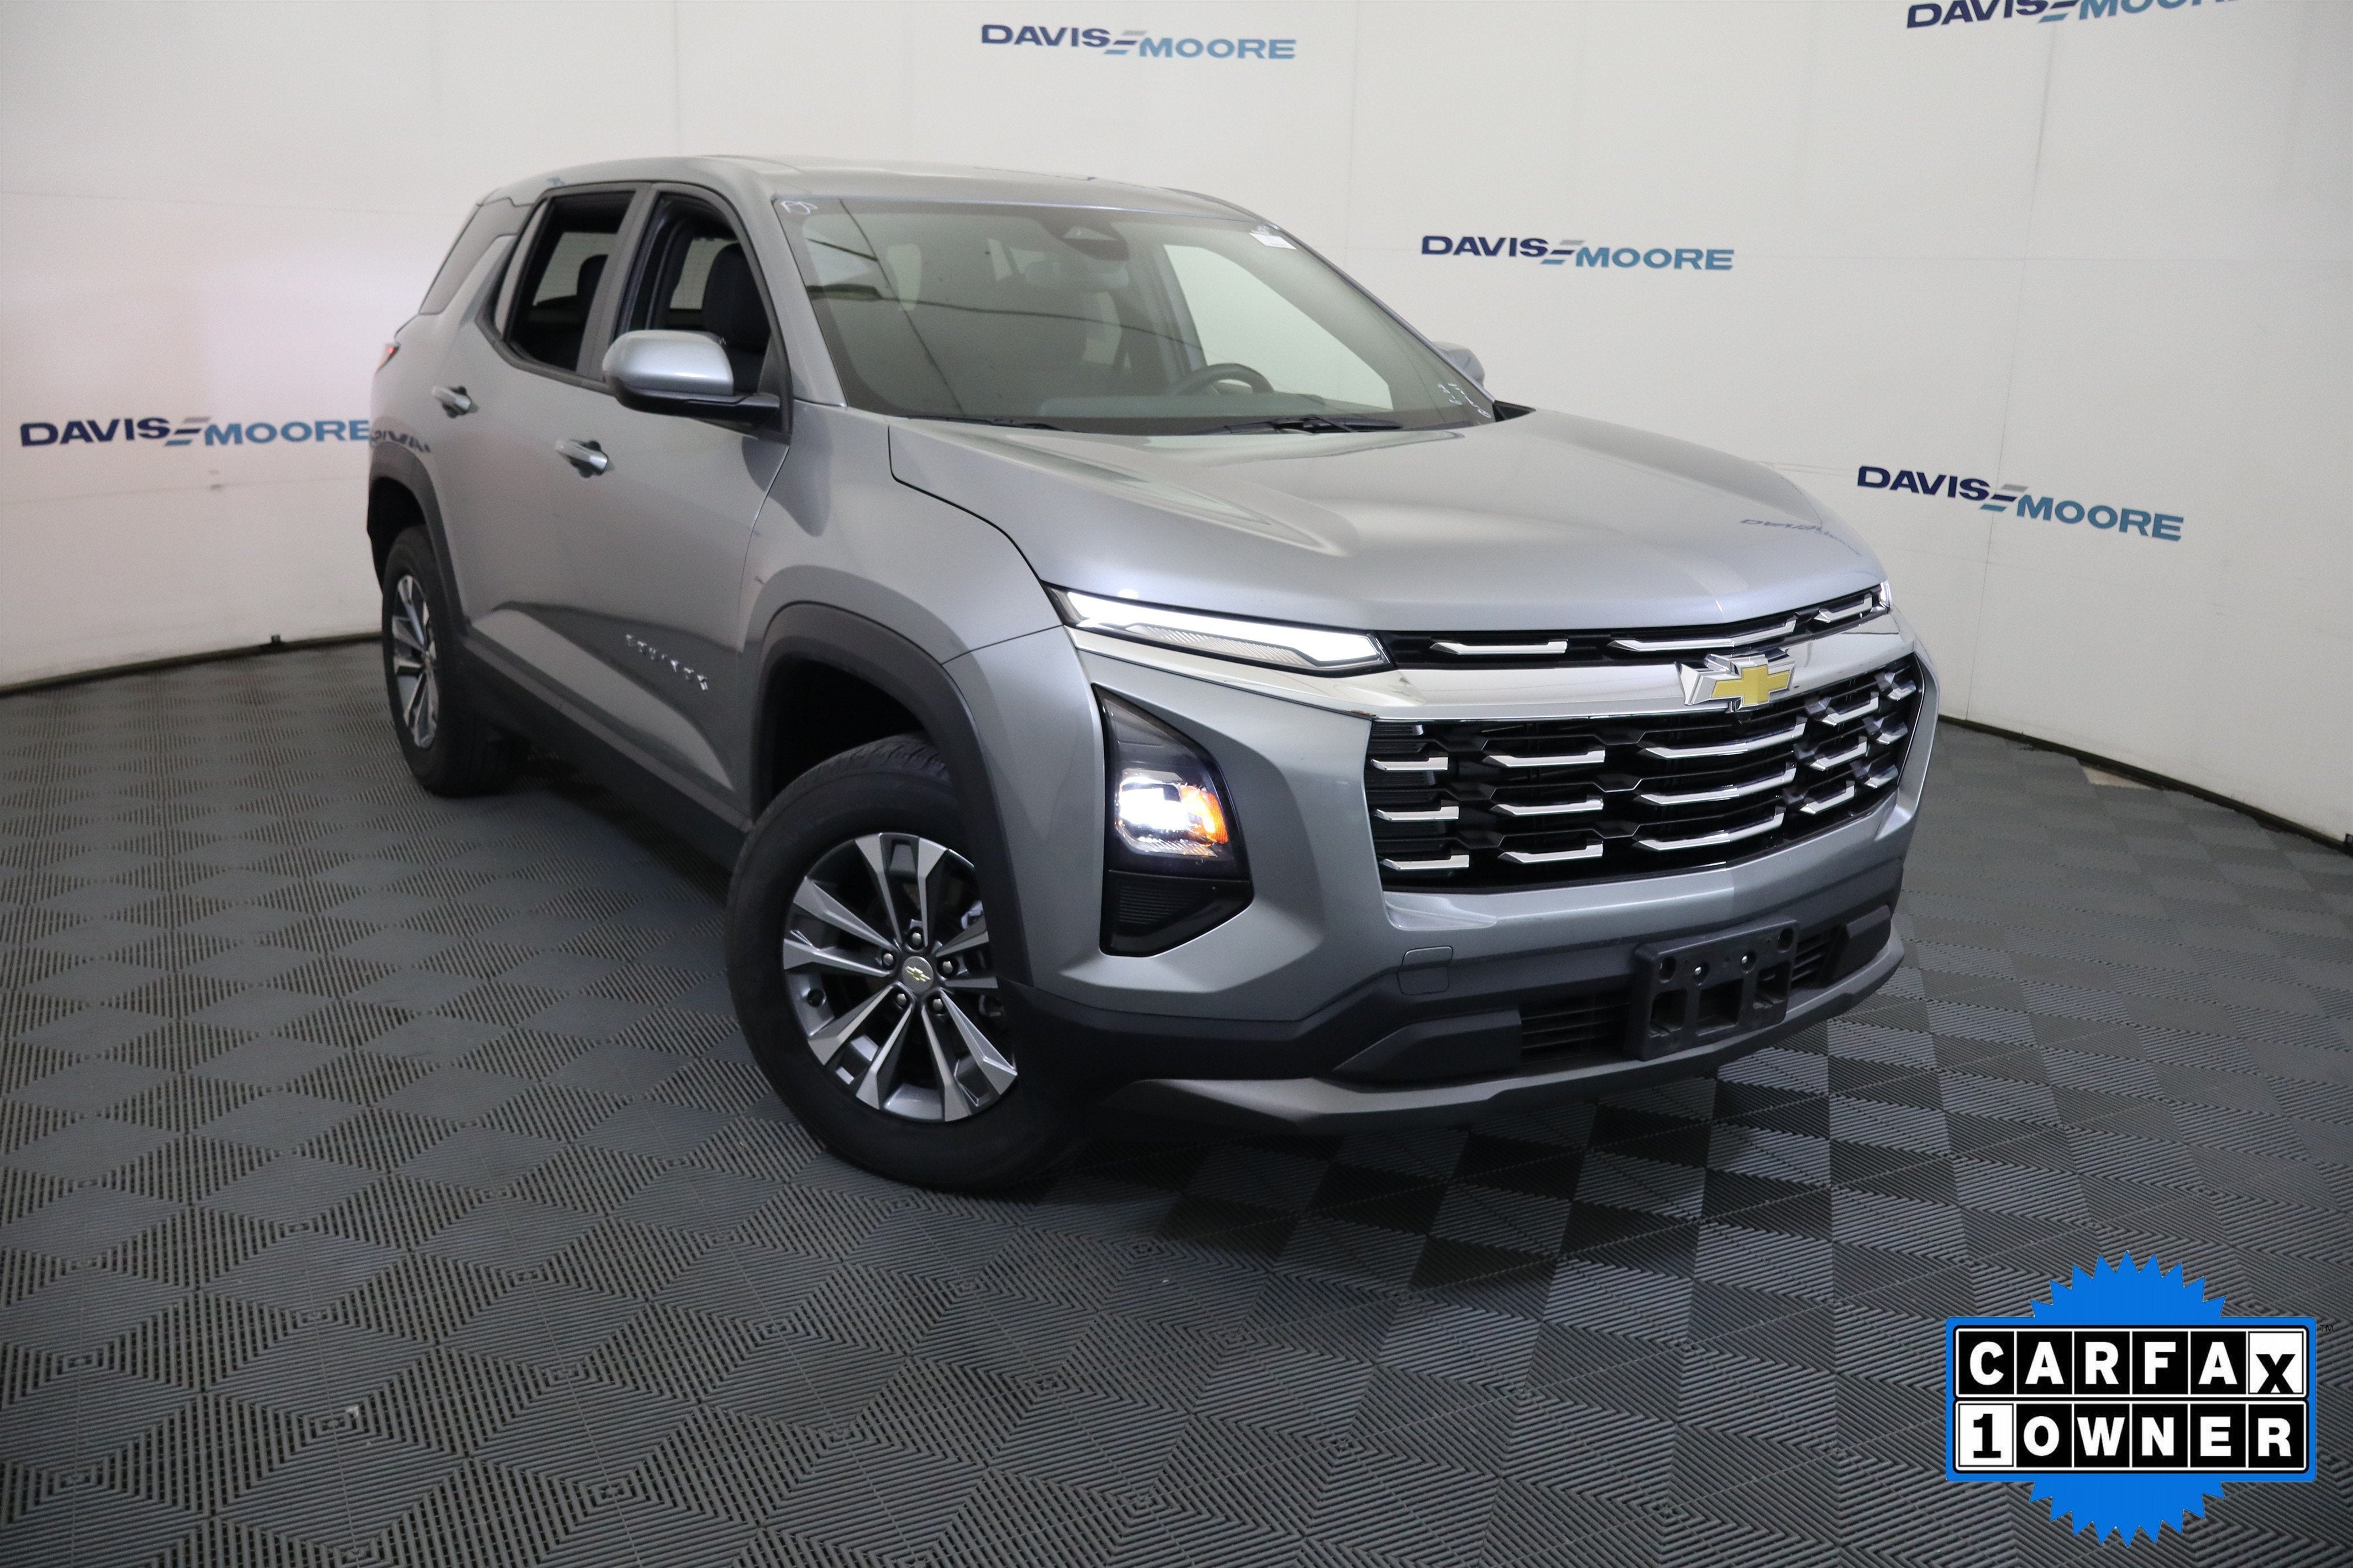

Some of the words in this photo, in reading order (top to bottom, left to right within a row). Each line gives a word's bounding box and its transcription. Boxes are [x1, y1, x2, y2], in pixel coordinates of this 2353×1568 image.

[1907, 0, 2049, 29] DAVIS
[981, 24, 1110, 48] DAVIS
[1140, 38, 1296, 59] MOORE
[1421, 235, 1549, 257] DAVIS
[1576, 247, 1734, 271] MOORE
[20, 417, 171, 447] DAVIS
[205, 420, 371, 446] MOORE
[1857, 466, 1990, 501] DAVIS
[2016, 495, 2184, 542] MOORE
